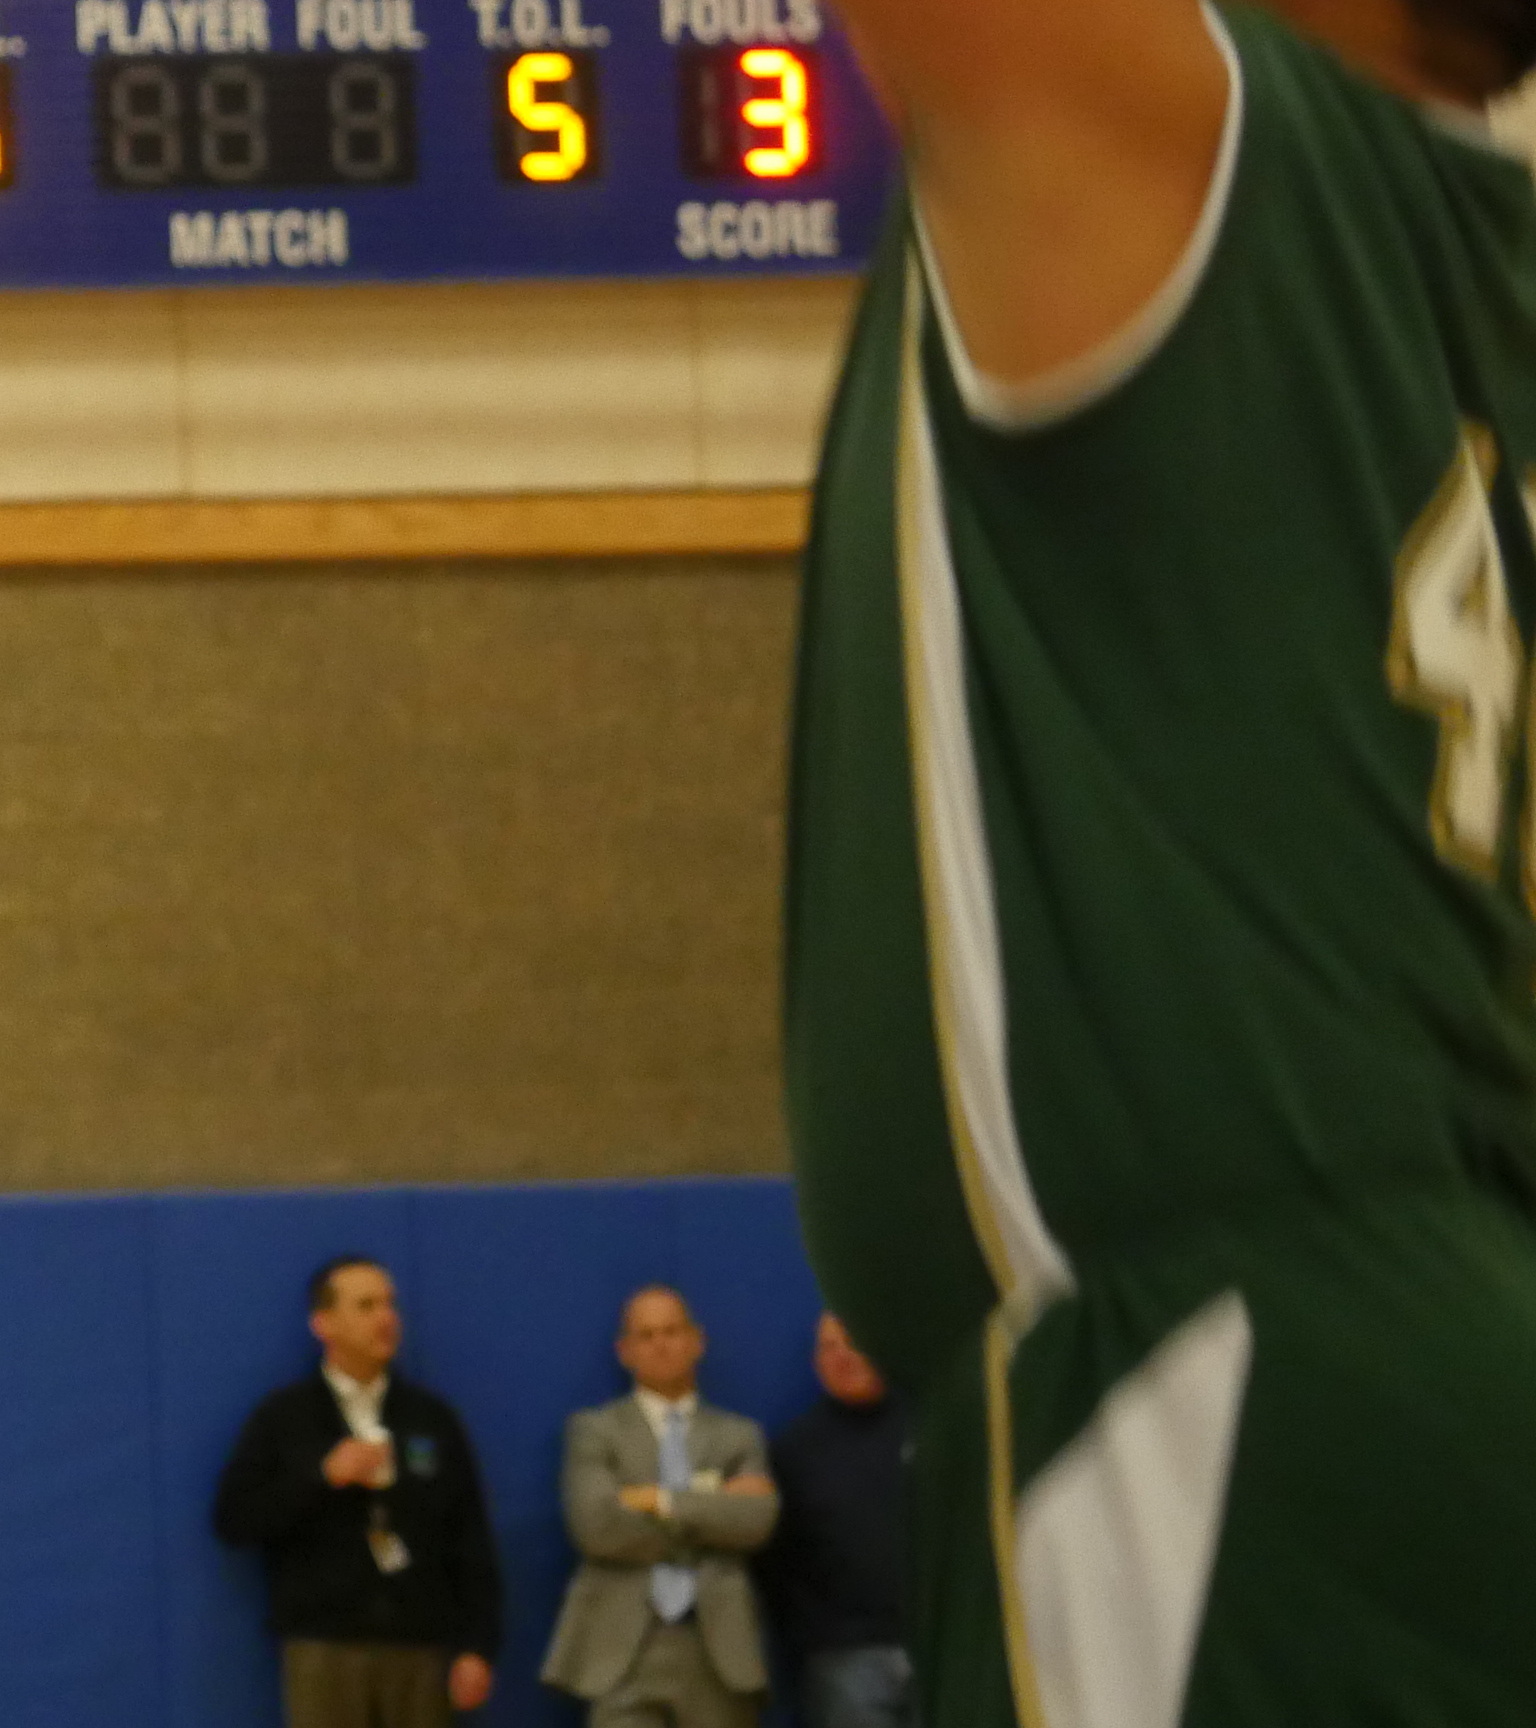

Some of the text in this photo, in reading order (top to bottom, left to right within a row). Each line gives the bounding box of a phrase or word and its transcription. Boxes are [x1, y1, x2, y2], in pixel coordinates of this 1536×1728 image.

[507, 51, 589, 182] 5
[739, 48, 810, 179] 3
[169, 209, 349, 268] MATCH
[675, 200, 840, 260] SCORE
[1385, 412, 1536, 922] 4
